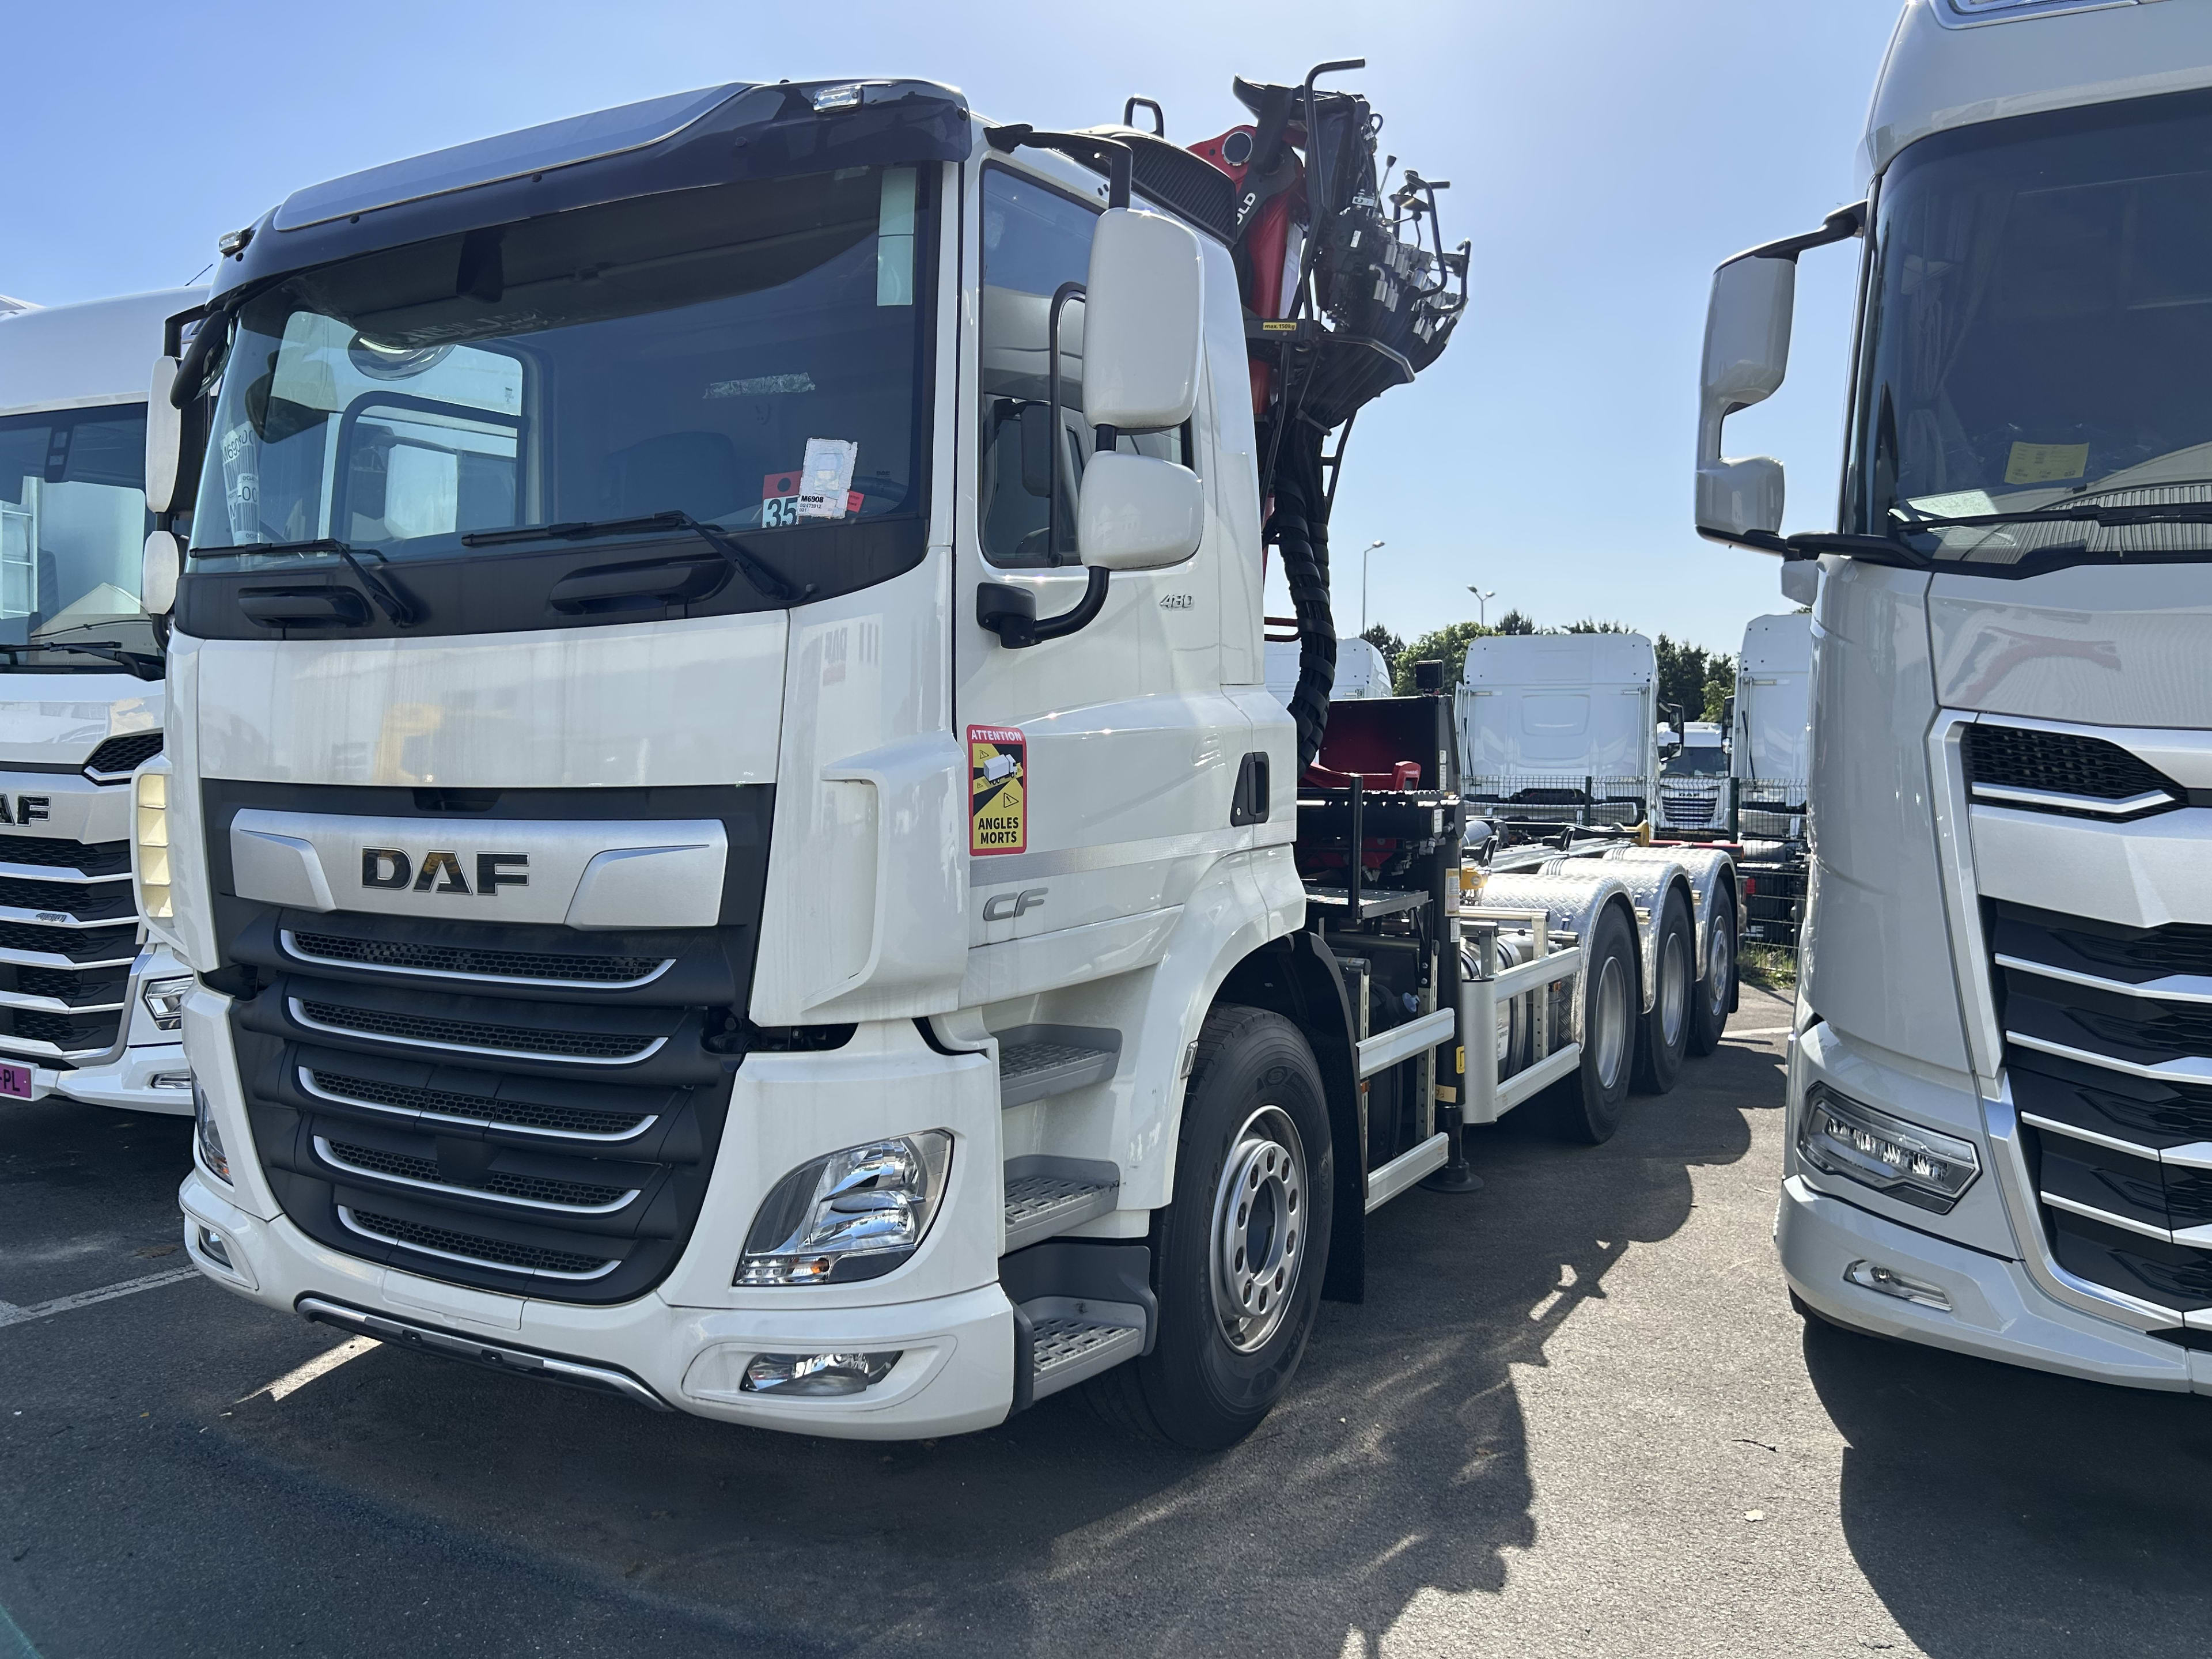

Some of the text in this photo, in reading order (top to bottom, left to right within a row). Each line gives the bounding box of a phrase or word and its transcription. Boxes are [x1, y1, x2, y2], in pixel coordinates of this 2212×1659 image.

[971, 729, 1022, 741] ATTENTION
[978, 817, 1019, 830] ANGLES
[980, 831, 1017, 844] MORTS
[362, 846, 530, 896] DAF
[983, 887, 1048, 922] CF
